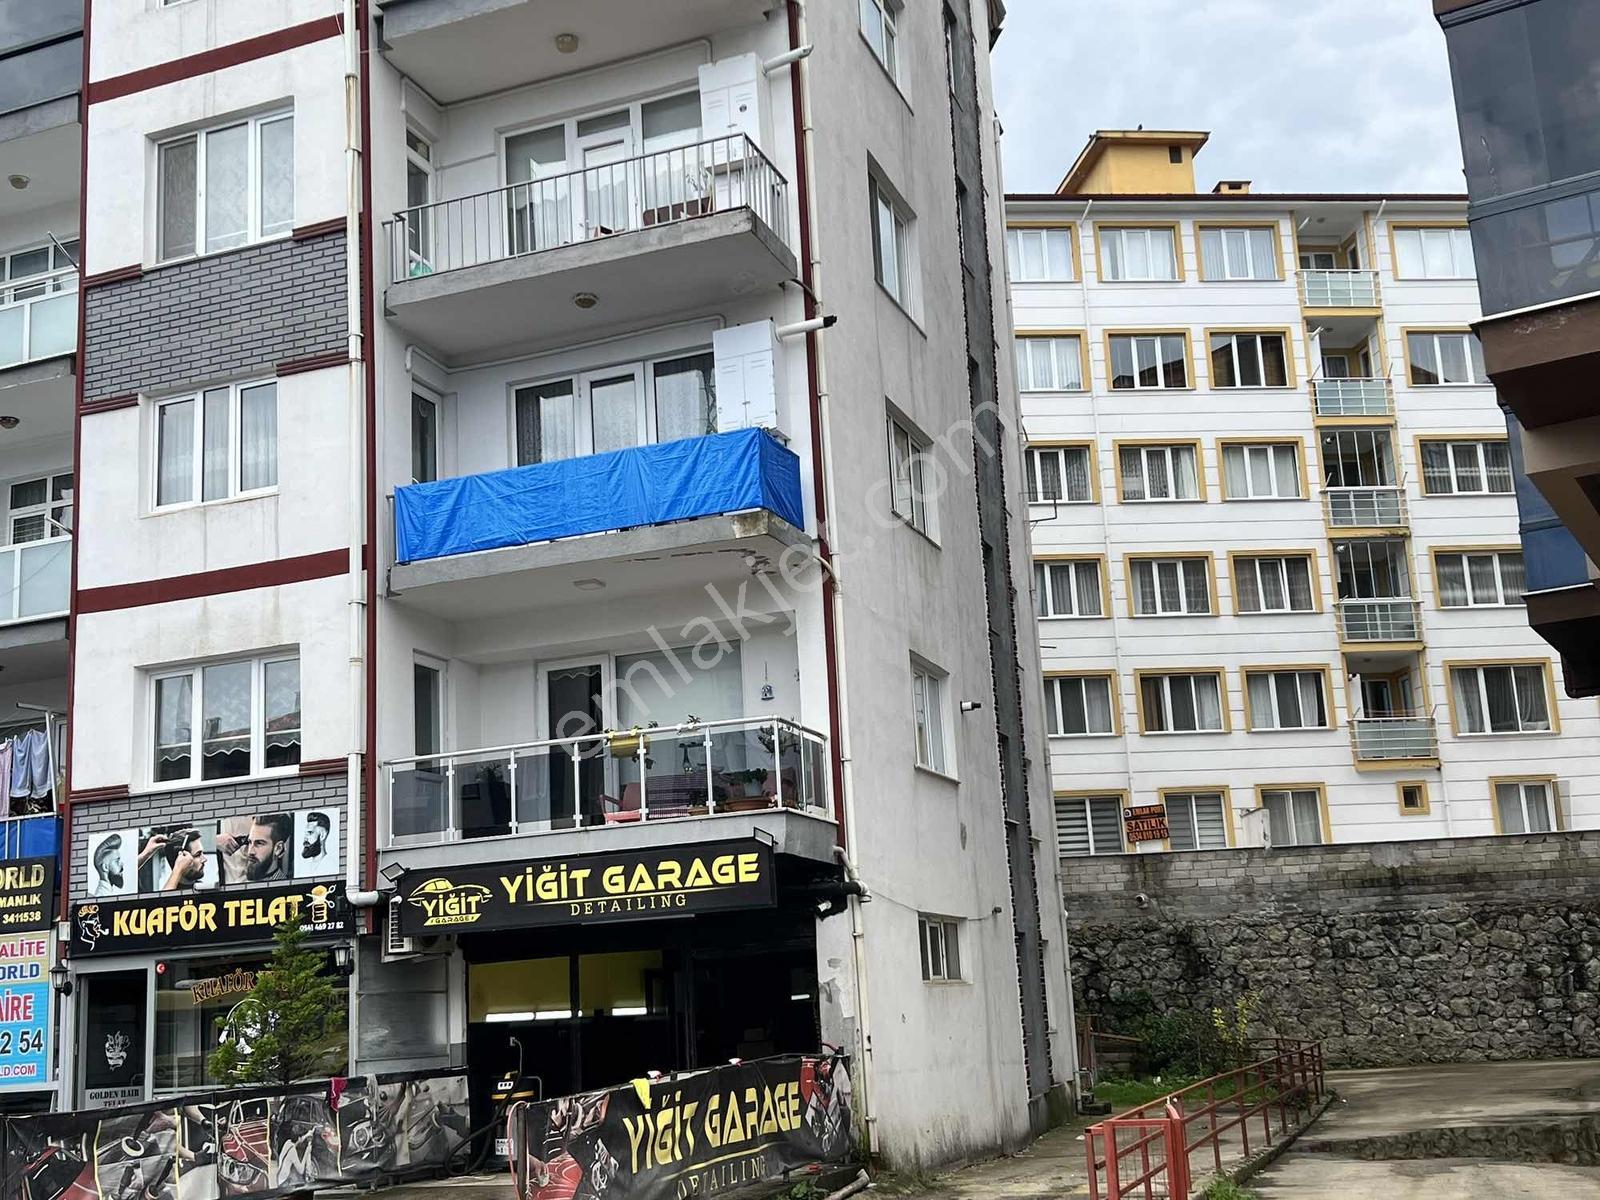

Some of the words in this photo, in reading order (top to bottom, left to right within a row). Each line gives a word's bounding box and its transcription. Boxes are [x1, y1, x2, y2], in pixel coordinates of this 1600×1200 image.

[1126, 819, 1166, 832] SATILIK
[500, 863, 592, 904] YİĞİT
[602, 853, 760, 894] GARAGE
[113, 900, 216, 937] KUAFÖR
[224, 895, 304, 926] TELAT
[421, 892, 481, 917] YİĞİT
[571, 894, 687, 916] DETAILING
[435, 915, 470, 924] GARAGE
[19, 1029, 43, 1053] 54
[89, 1091, 119, 1100] GOLDEN
[121, 1089, 139, 1098] HAIR
[622, 1090, 699, 1174] YİĞİT
[704, 1081, 801, 1148] GARAGE
[676, 1155, 767, 1200] DETAILING
